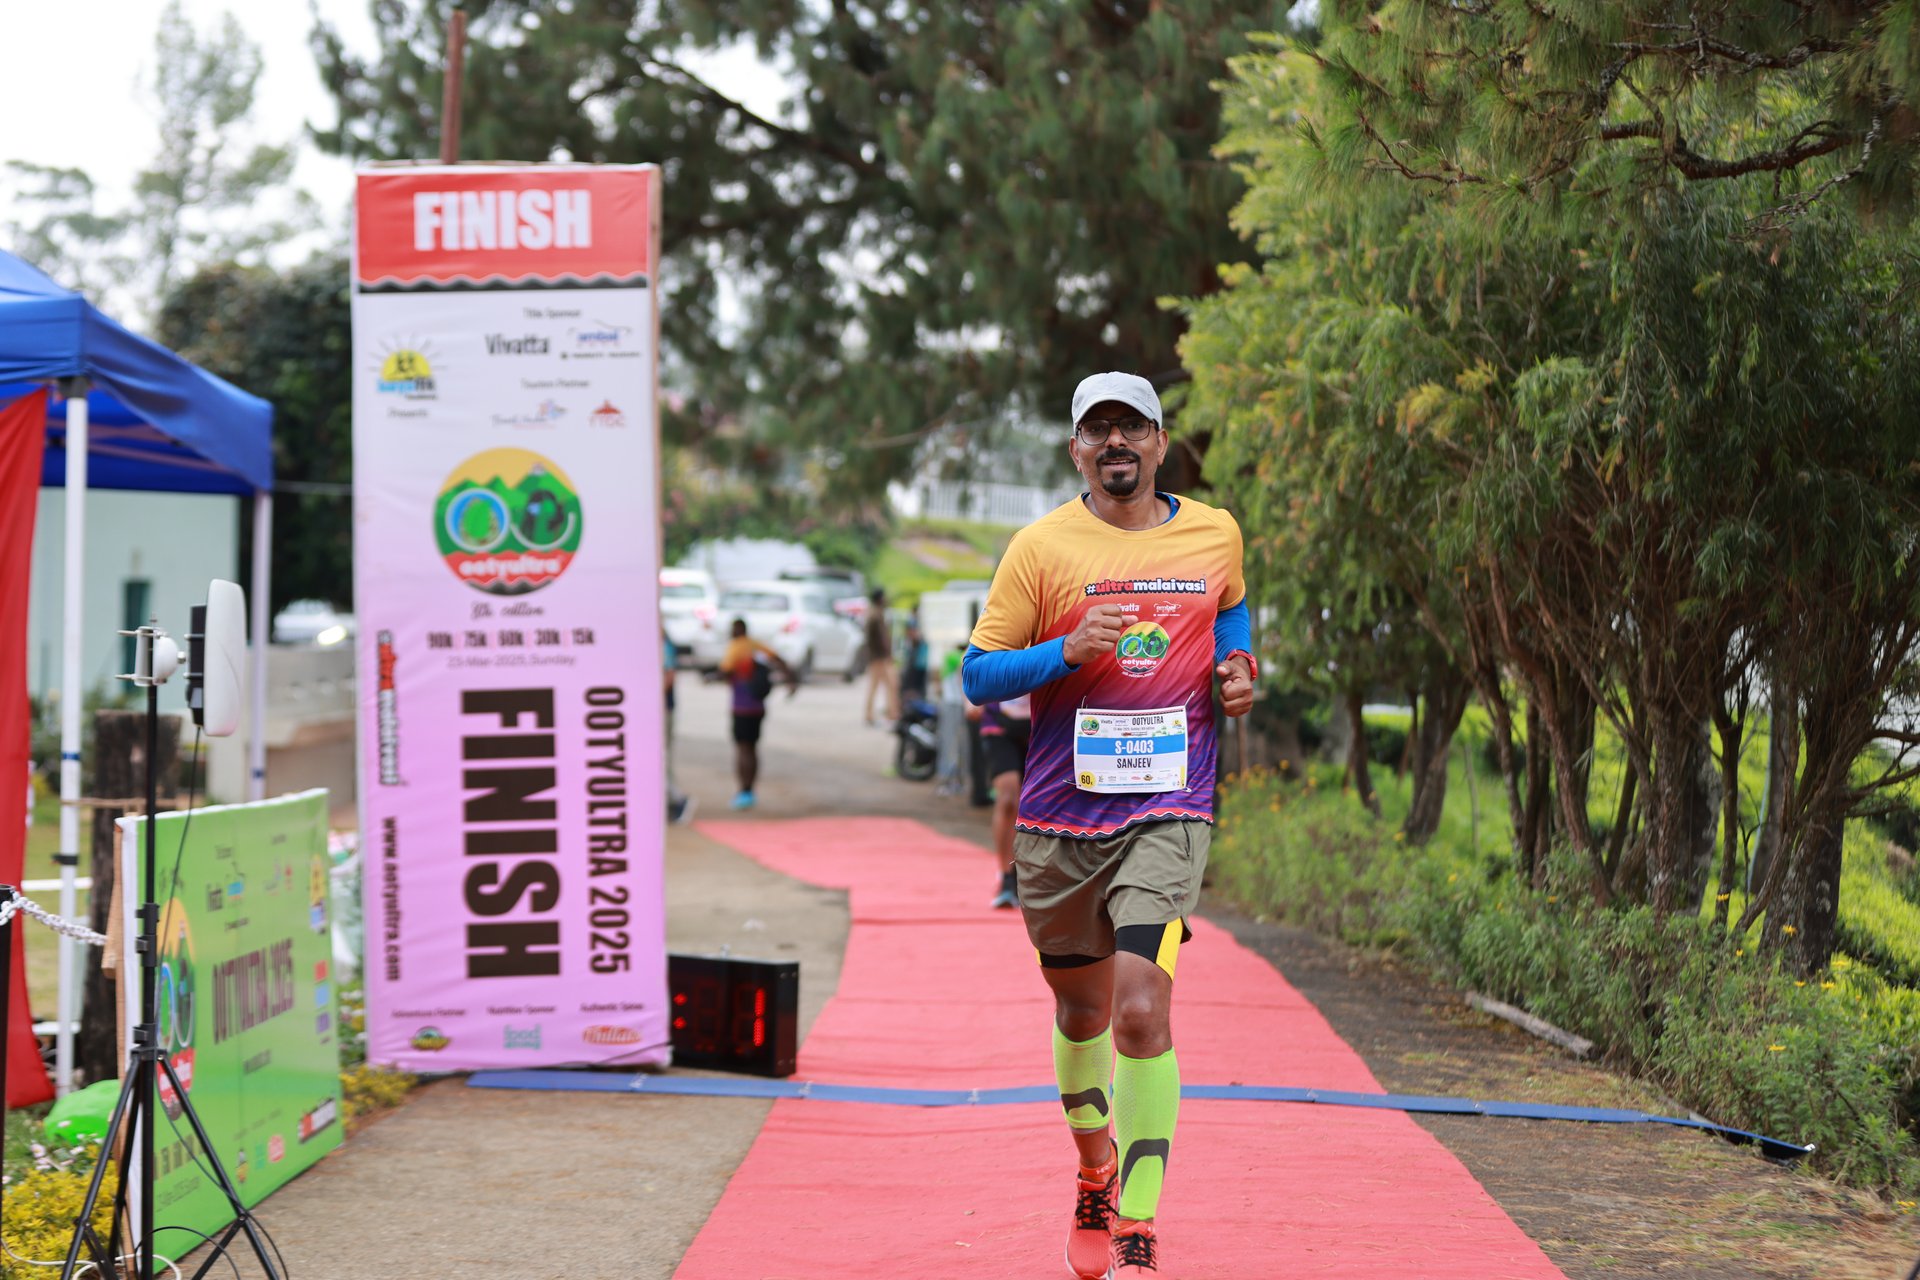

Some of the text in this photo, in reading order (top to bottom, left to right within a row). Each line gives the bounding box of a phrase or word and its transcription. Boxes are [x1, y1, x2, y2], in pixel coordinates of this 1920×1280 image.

[413, 189, 592, 251] FINISH
[484, 332, 550, 356] Vivatta
[1086, 579, 1206, 595] #ultramalaivasi
[1131, 716, 1164, 726] OOTYULTRA
[1114, 740, 1154, 754] S-0403
[1116, 758, 1152, 768] SANJEEV
[583, 686, 629, 878] OOTYULTRA
[460, 688, 561, 978] FINISH
[588, 887, 631, 974] 2025
